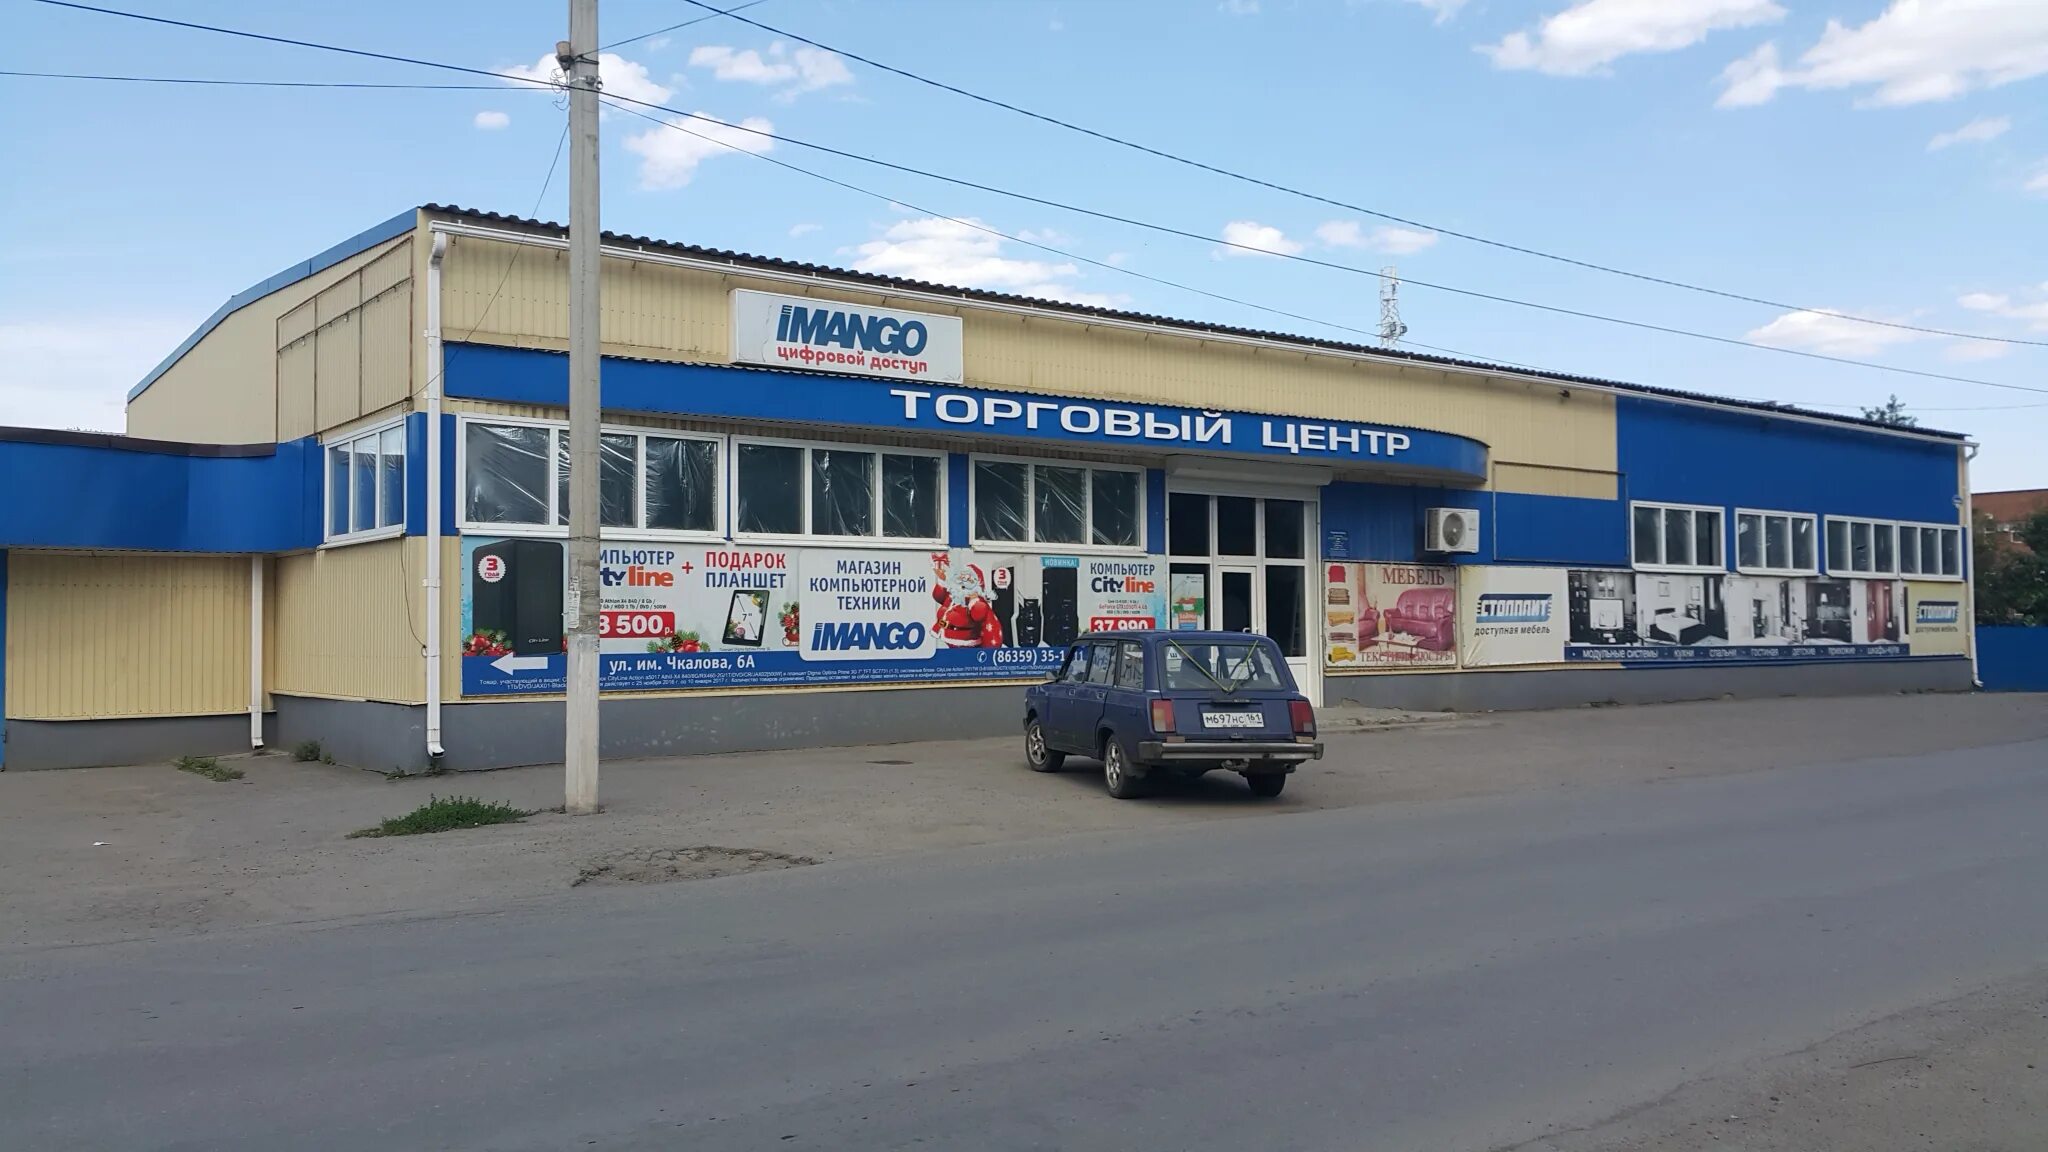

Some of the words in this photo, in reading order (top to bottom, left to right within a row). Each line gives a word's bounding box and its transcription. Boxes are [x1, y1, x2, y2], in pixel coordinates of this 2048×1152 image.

[778, 345, 865, 366] цифровой
[870, 356, 928, 374] доступ
[890, 389, 1232, 444] ТОРГОВЫЙ
[1262, 421, 1411, 456] ЦЕНТР
[486, 558, 498, 571] 3
[600, 549, 675, 565] МПЬЮТЕР
[705, 551, 786, 571] ПОДАРОК
[837, 560, 901, 575] МАГАЗИН
[1090, 563, 1155, 576] КОМПЬЮТЕР
[1382, 567, 1445, 585] МЕБЕЛЬ
[705, 572, 787, 588] ПЛАНШЕТ
[809, 576, 926, 593] КОМПЬЮТЕРНОЙ
[837, 596, 901, 610] ТЕХНИКИ
[616, 614, 663, 634] 500
[1474, 627, 1519, 637] доступная
[1520, 625, 1550, 634] мебель
[609, 660, 632, 675] ул.
[637, 660, 662, 671] им.
[667, 656, 732, 670] Чкалова,
[992, 649, 1037, 666] (86359)
